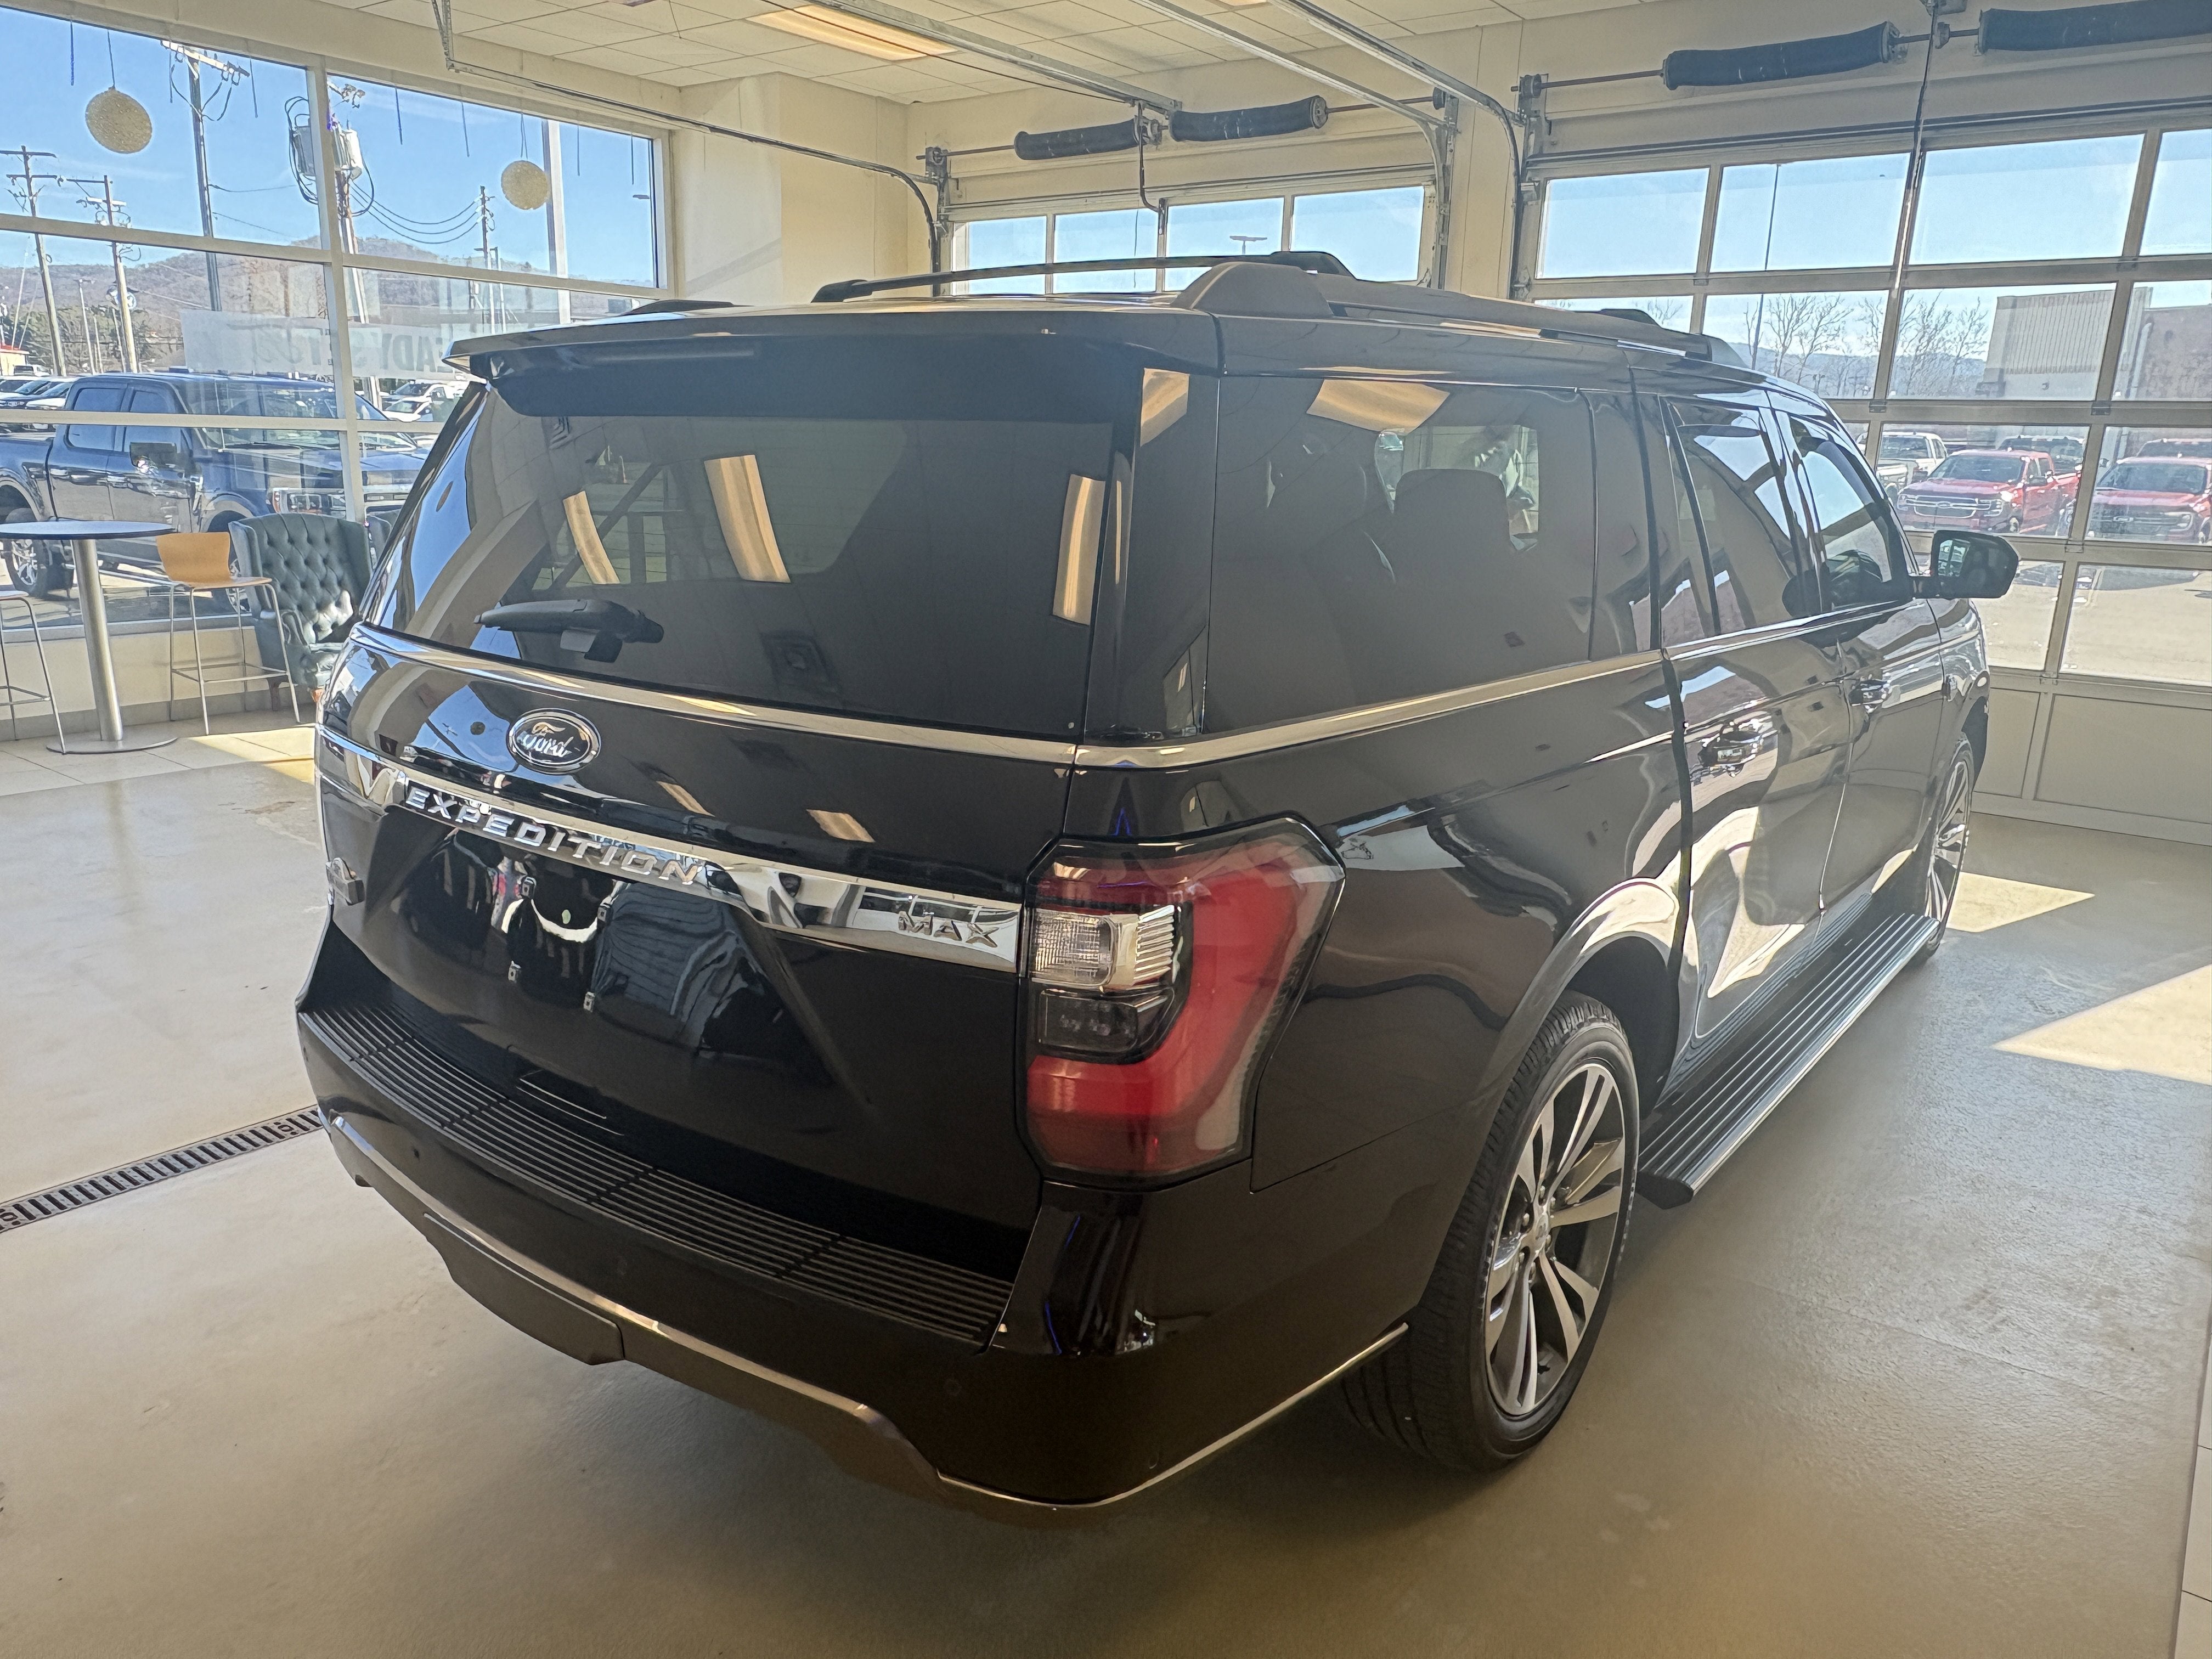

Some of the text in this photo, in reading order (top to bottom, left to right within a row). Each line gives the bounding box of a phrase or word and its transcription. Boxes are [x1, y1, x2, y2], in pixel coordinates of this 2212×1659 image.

[517, 721, 573, 758] Ford
[405, 786, 1000, 948] EXPEDITION MAX
